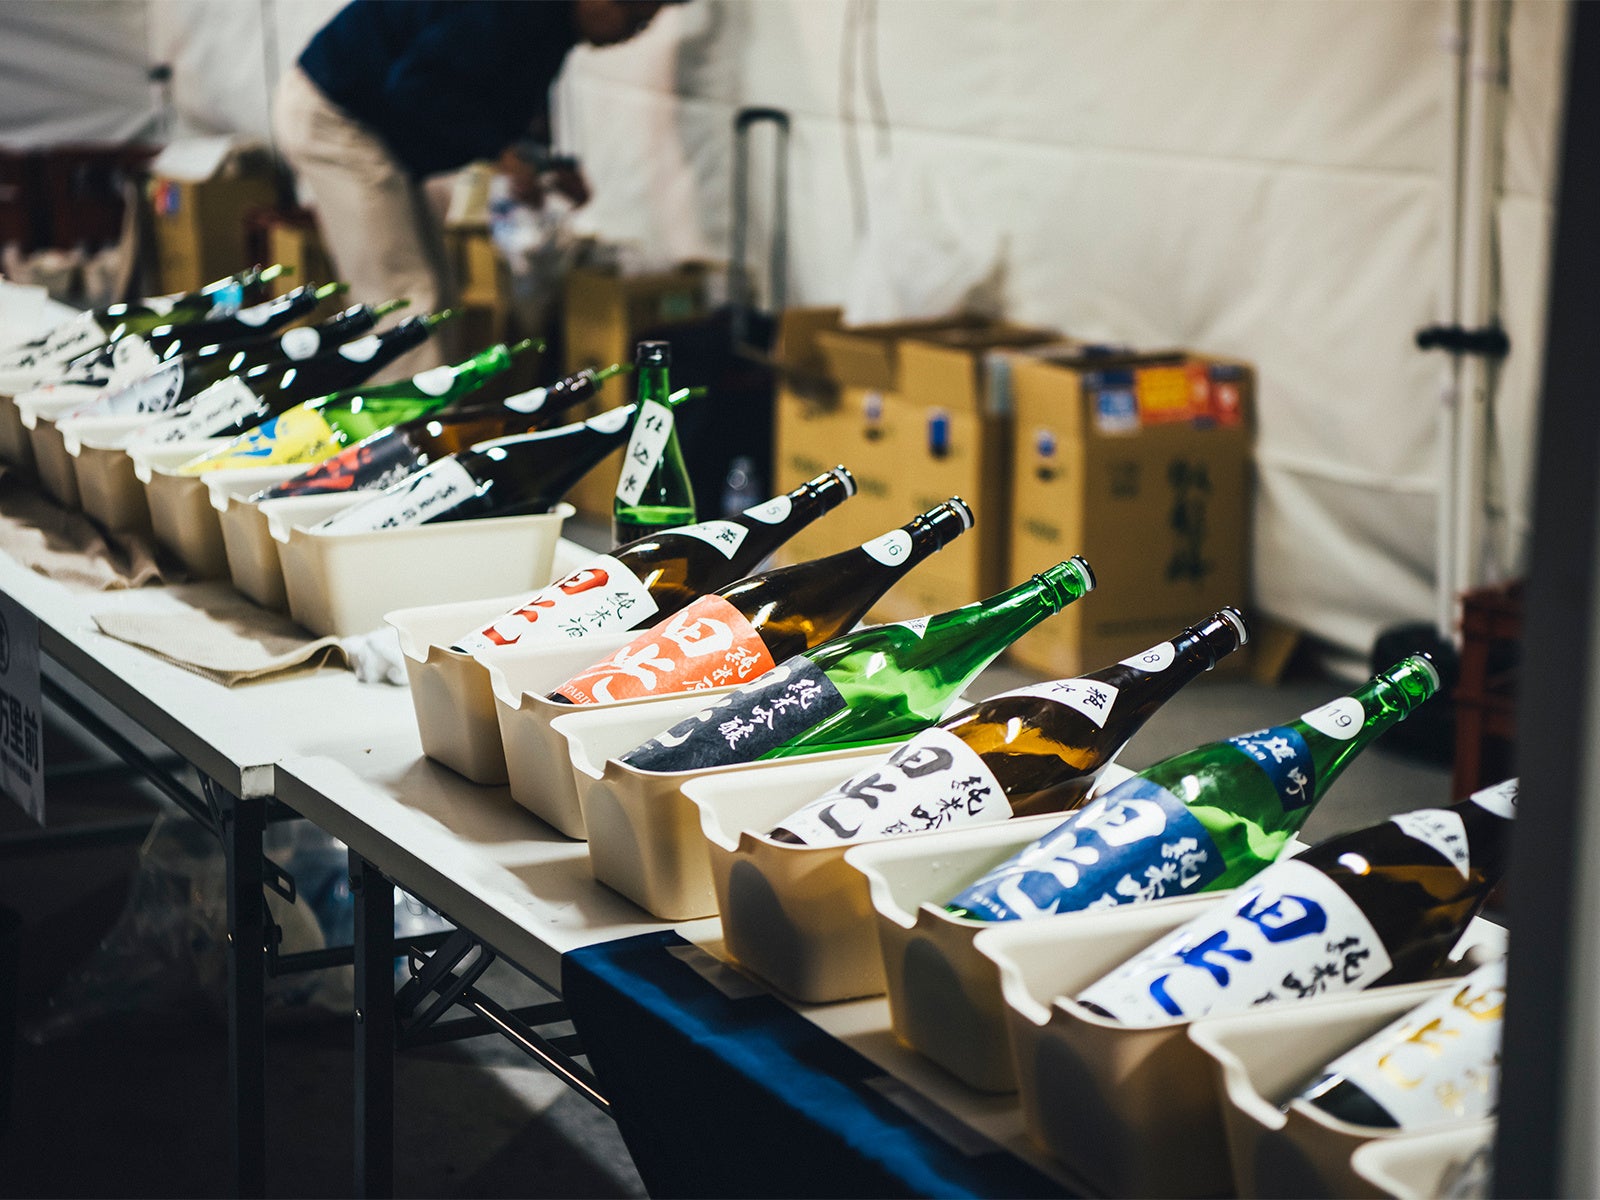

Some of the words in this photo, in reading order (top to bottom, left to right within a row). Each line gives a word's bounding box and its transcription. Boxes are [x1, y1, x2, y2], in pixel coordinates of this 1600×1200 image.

[883, 538, 902, 556] 16
[558, 592, 636, 638] 純米酒
